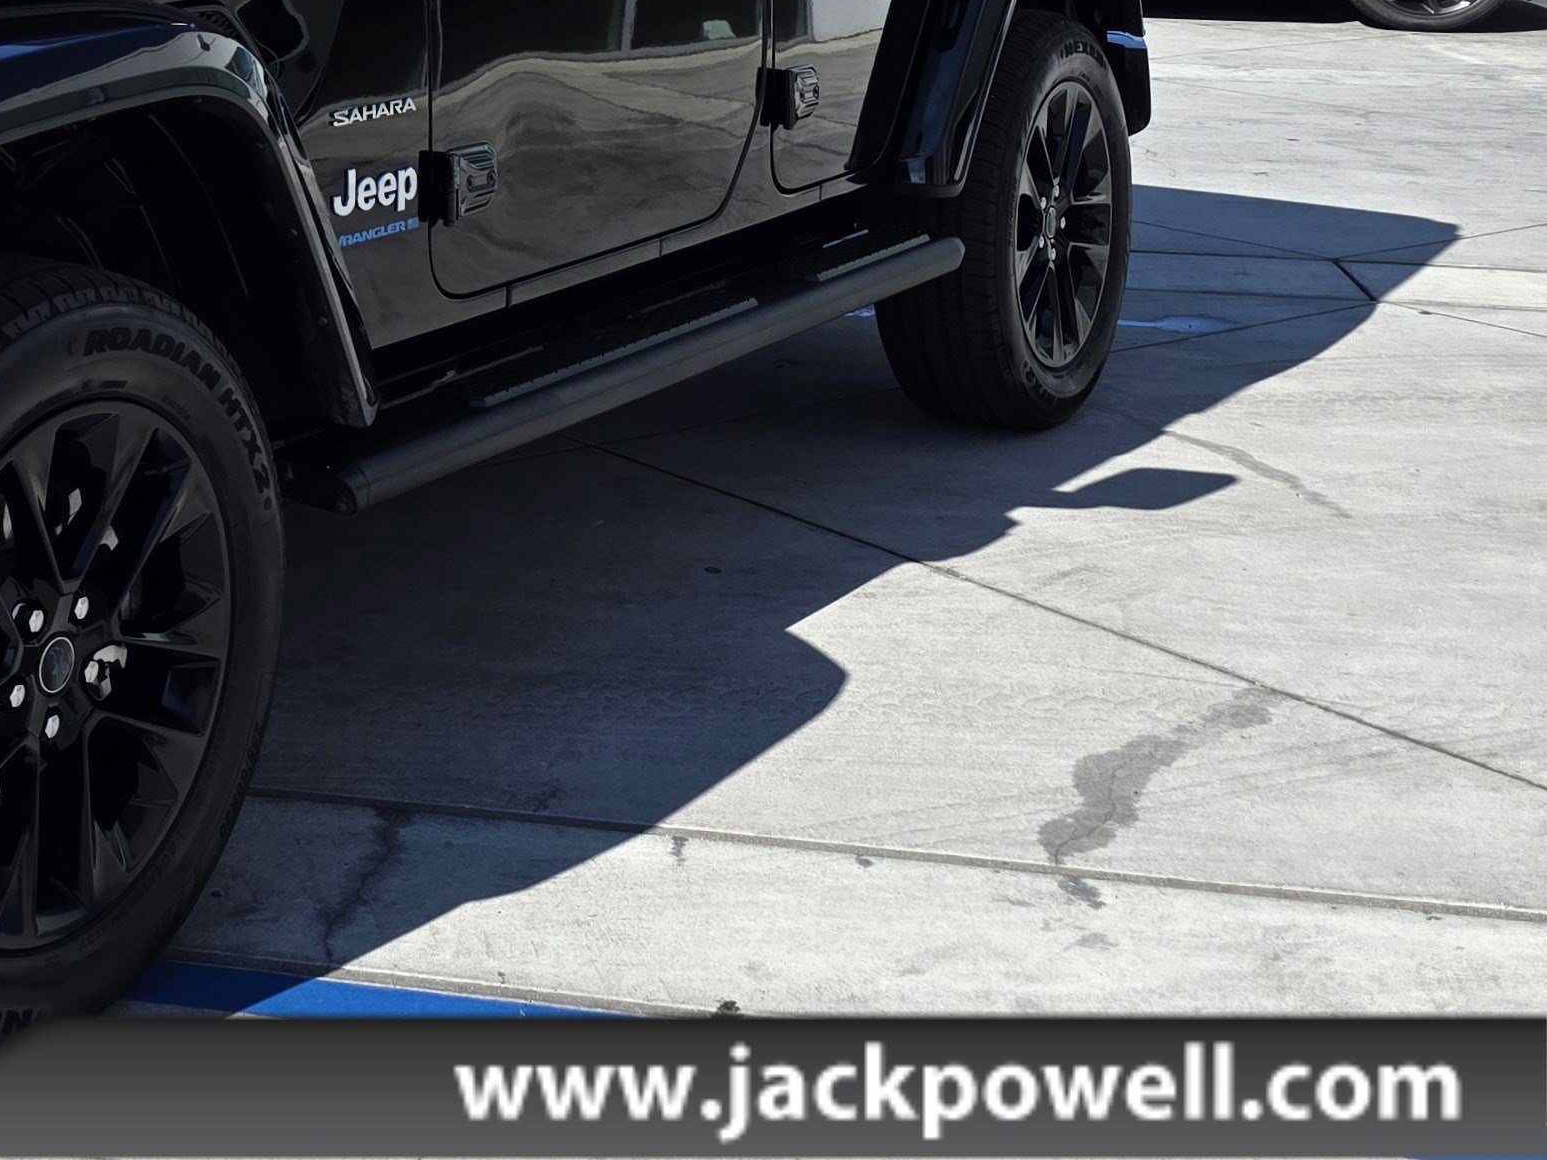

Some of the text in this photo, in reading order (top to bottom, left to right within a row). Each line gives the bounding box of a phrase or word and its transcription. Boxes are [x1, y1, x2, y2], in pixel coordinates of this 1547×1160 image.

[332, 97, 417, 127] SAHARA
[332, 166, 418, 216] Jeep
[83, 327, 222, 392] ROADIAN
